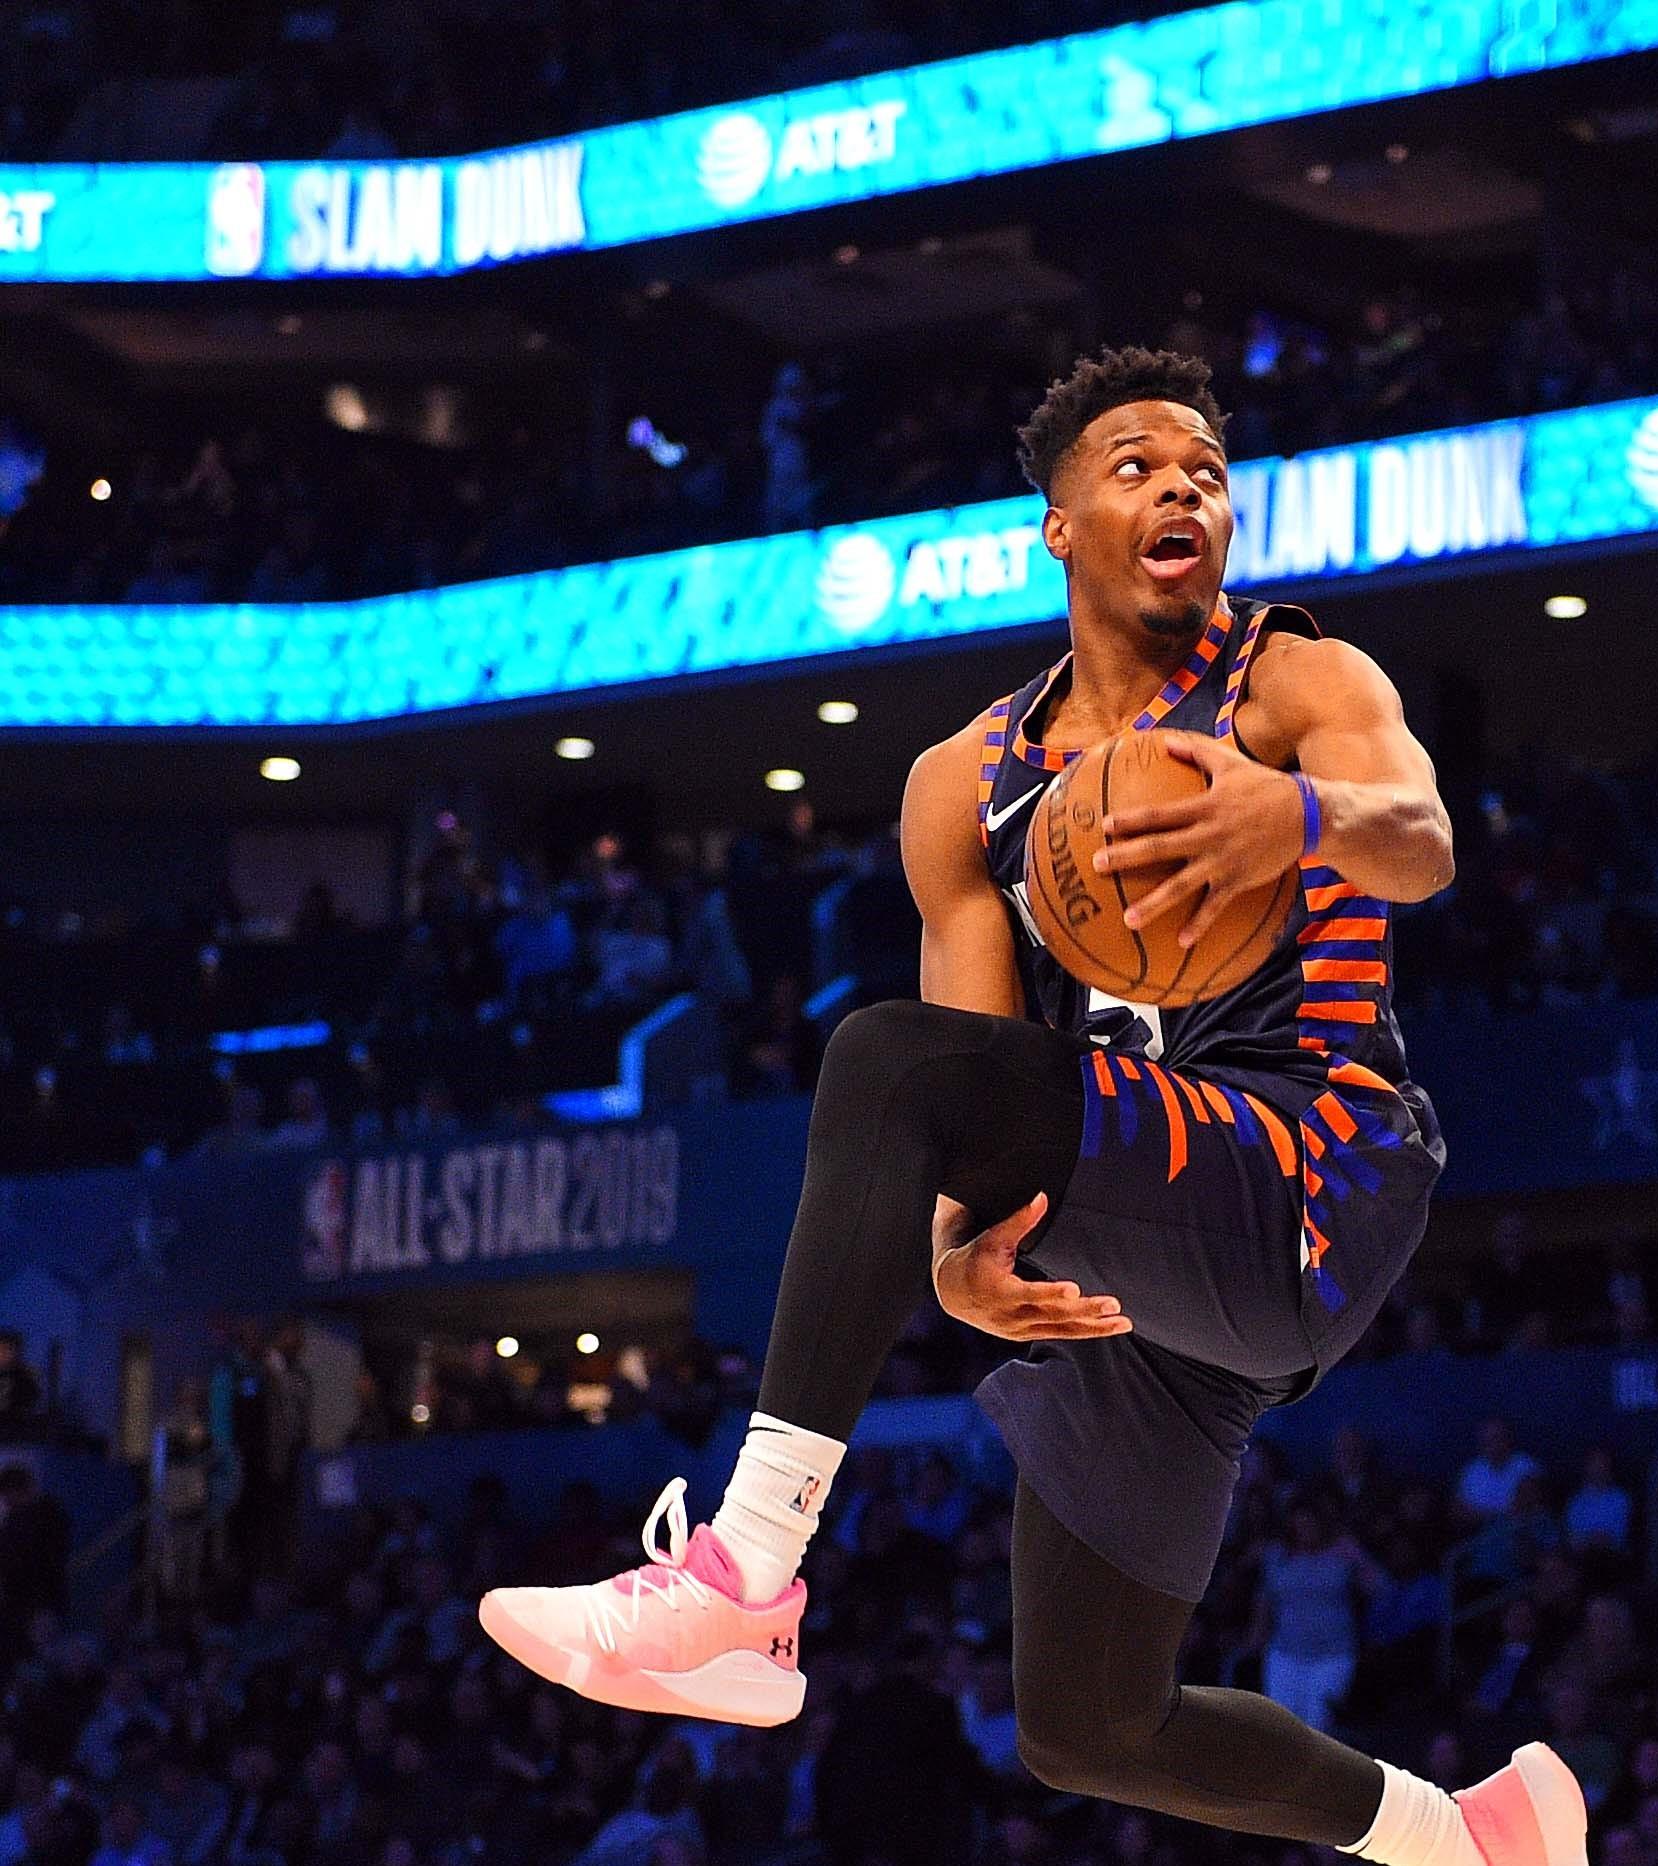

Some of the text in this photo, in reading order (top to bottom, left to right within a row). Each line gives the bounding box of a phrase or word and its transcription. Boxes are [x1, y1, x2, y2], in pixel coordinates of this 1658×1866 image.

[776, 101, 906, 182] AT&T
[286, 142, 587, 272] SLAM DUNK
[1367, 422, 1527, 566] DUNK
[899, 526, 1039, 608] AT&T
